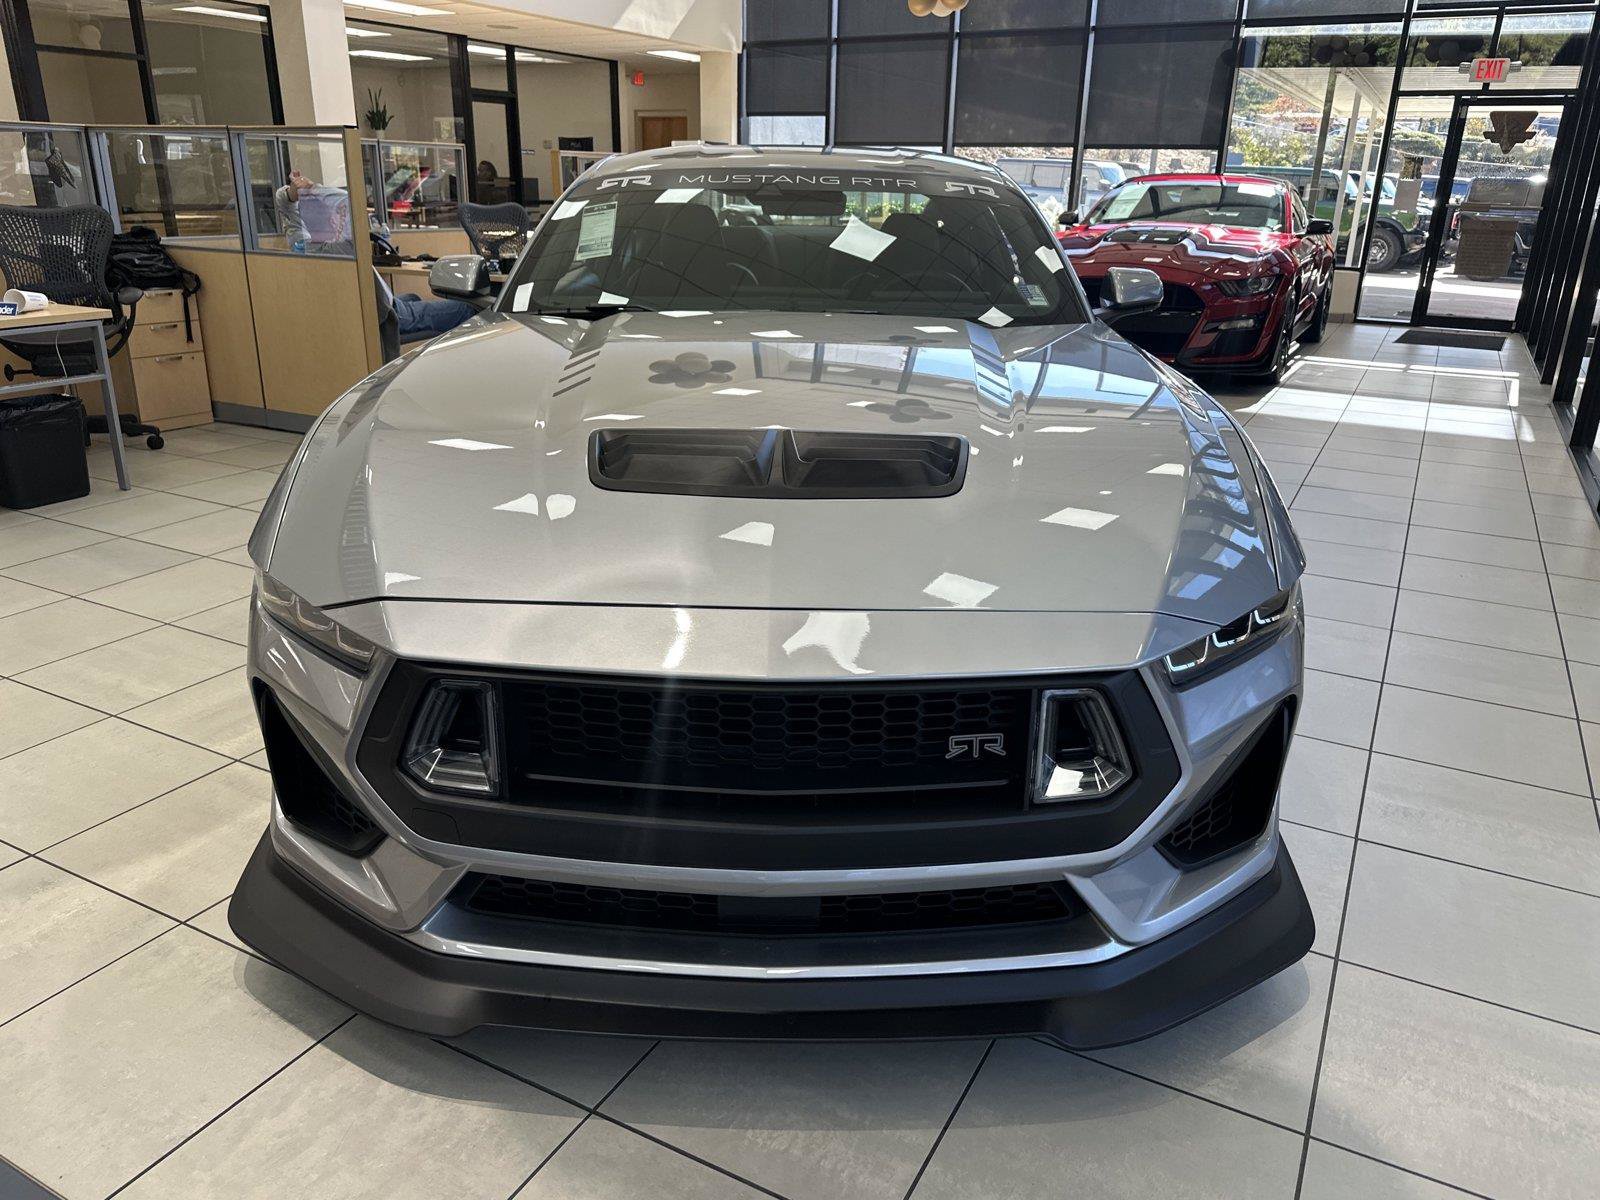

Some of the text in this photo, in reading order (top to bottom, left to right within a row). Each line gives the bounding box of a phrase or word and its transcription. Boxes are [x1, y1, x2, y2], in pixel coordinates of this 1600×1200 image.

[1475, 60, 1505, 80] EXIT
[596, 175, 652, 190] RTR
[678, 174, 917, 188] MUSTANG RTR
[944, 181, 1000, 198] RTR
[945, 733, 1006, 759] RTR
